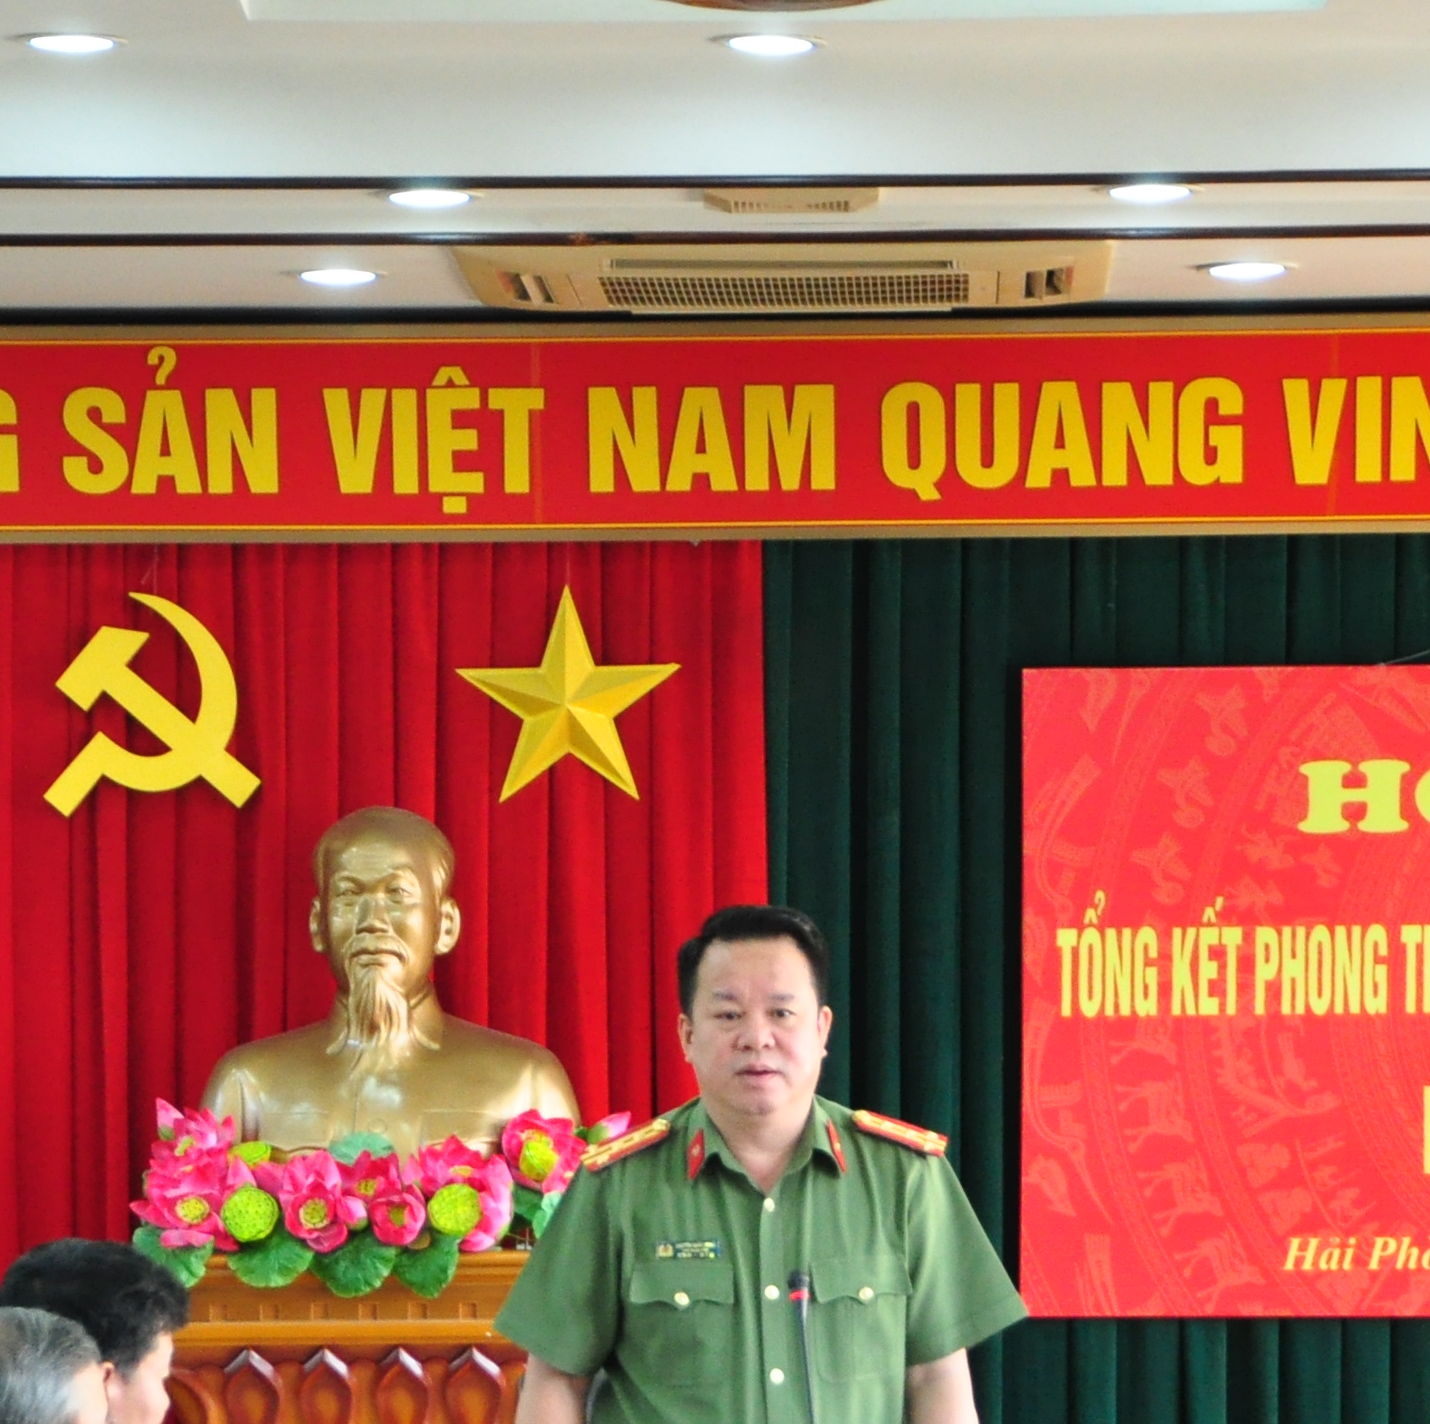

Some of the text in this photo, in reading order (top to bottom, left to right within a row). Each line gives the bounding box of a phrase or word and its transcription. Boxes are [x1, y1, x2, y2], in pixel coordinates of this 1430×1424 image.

[63, 346, 278, 494] SẢN
[323, 367, 544, 513] VIỆT
[589, 385, 835, 492] NAM
[882, 376, 1243, 501] QUANG
[1056, 890, 1158, 1018] TỔNG
[1171, 895, 1243, 1016] KẾT
[1254, 924, 1388, 1016] PHONG
